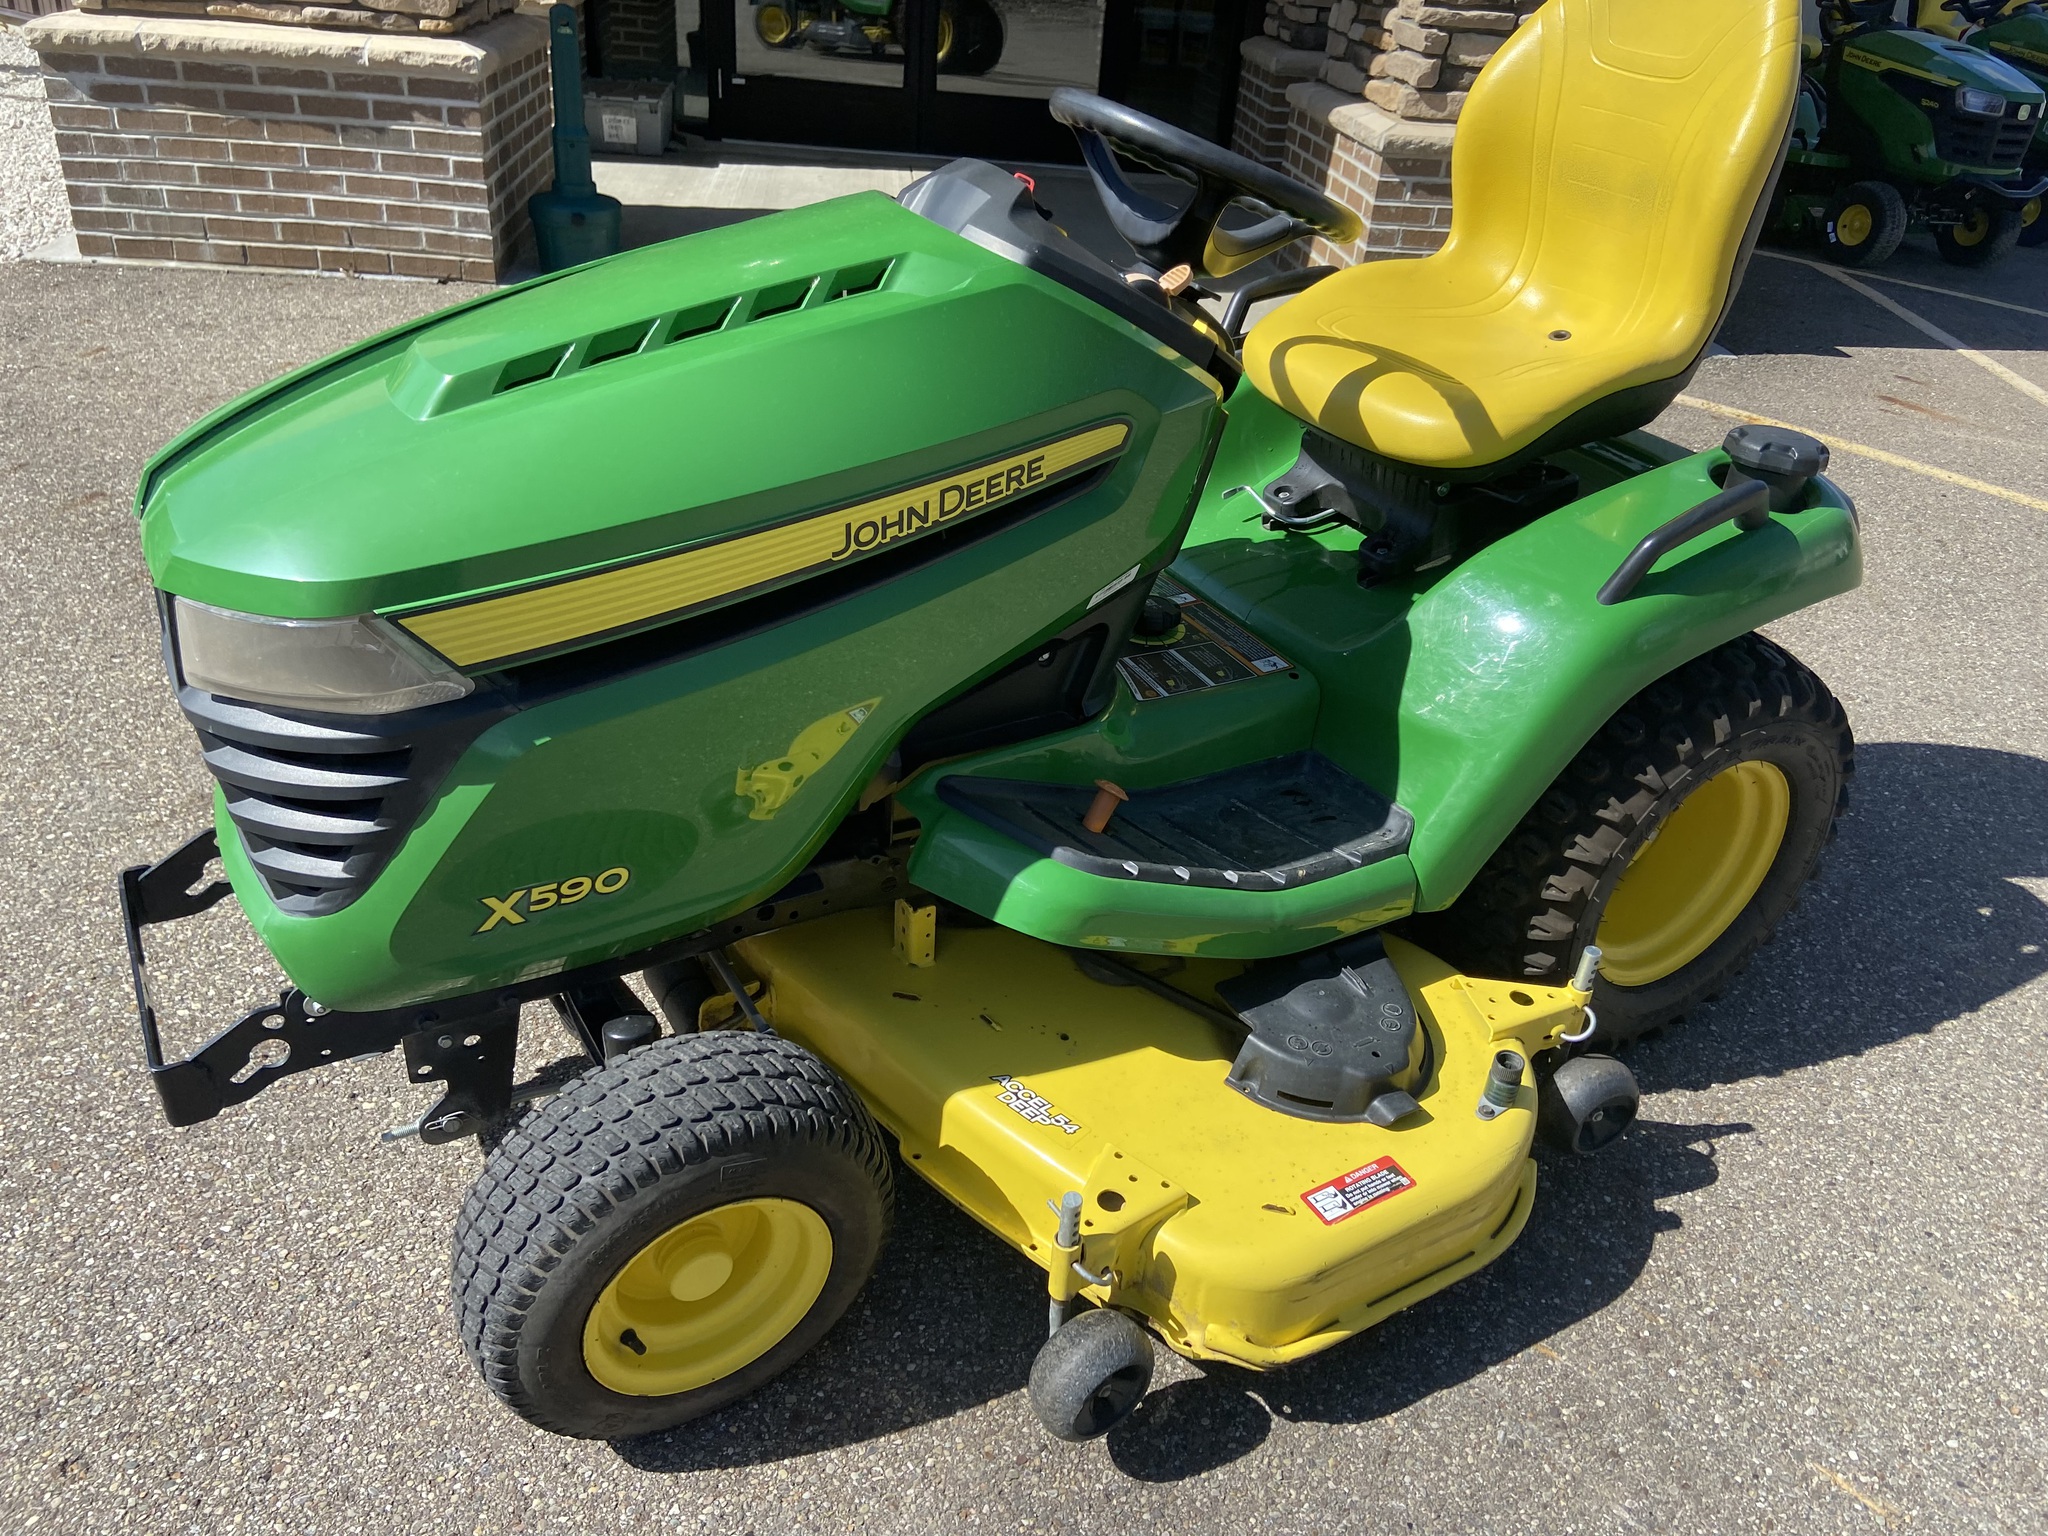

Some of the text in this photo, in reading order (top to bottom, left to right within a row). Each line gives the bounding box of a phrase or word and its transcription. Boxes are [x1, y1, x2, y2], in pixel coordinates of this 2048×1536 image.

[831, 455, 1046, 559] JOHN DEERE
[471, 866, 630, 936] X590
[989, 1075, 1055, 1118] ACCEL
[996, 1091, 1082, 1135] DEEP 54
[1344, 1169, 1390, 1192] ROTATING BLADE
[1350, 1163, 1379, 1180] DANGER
